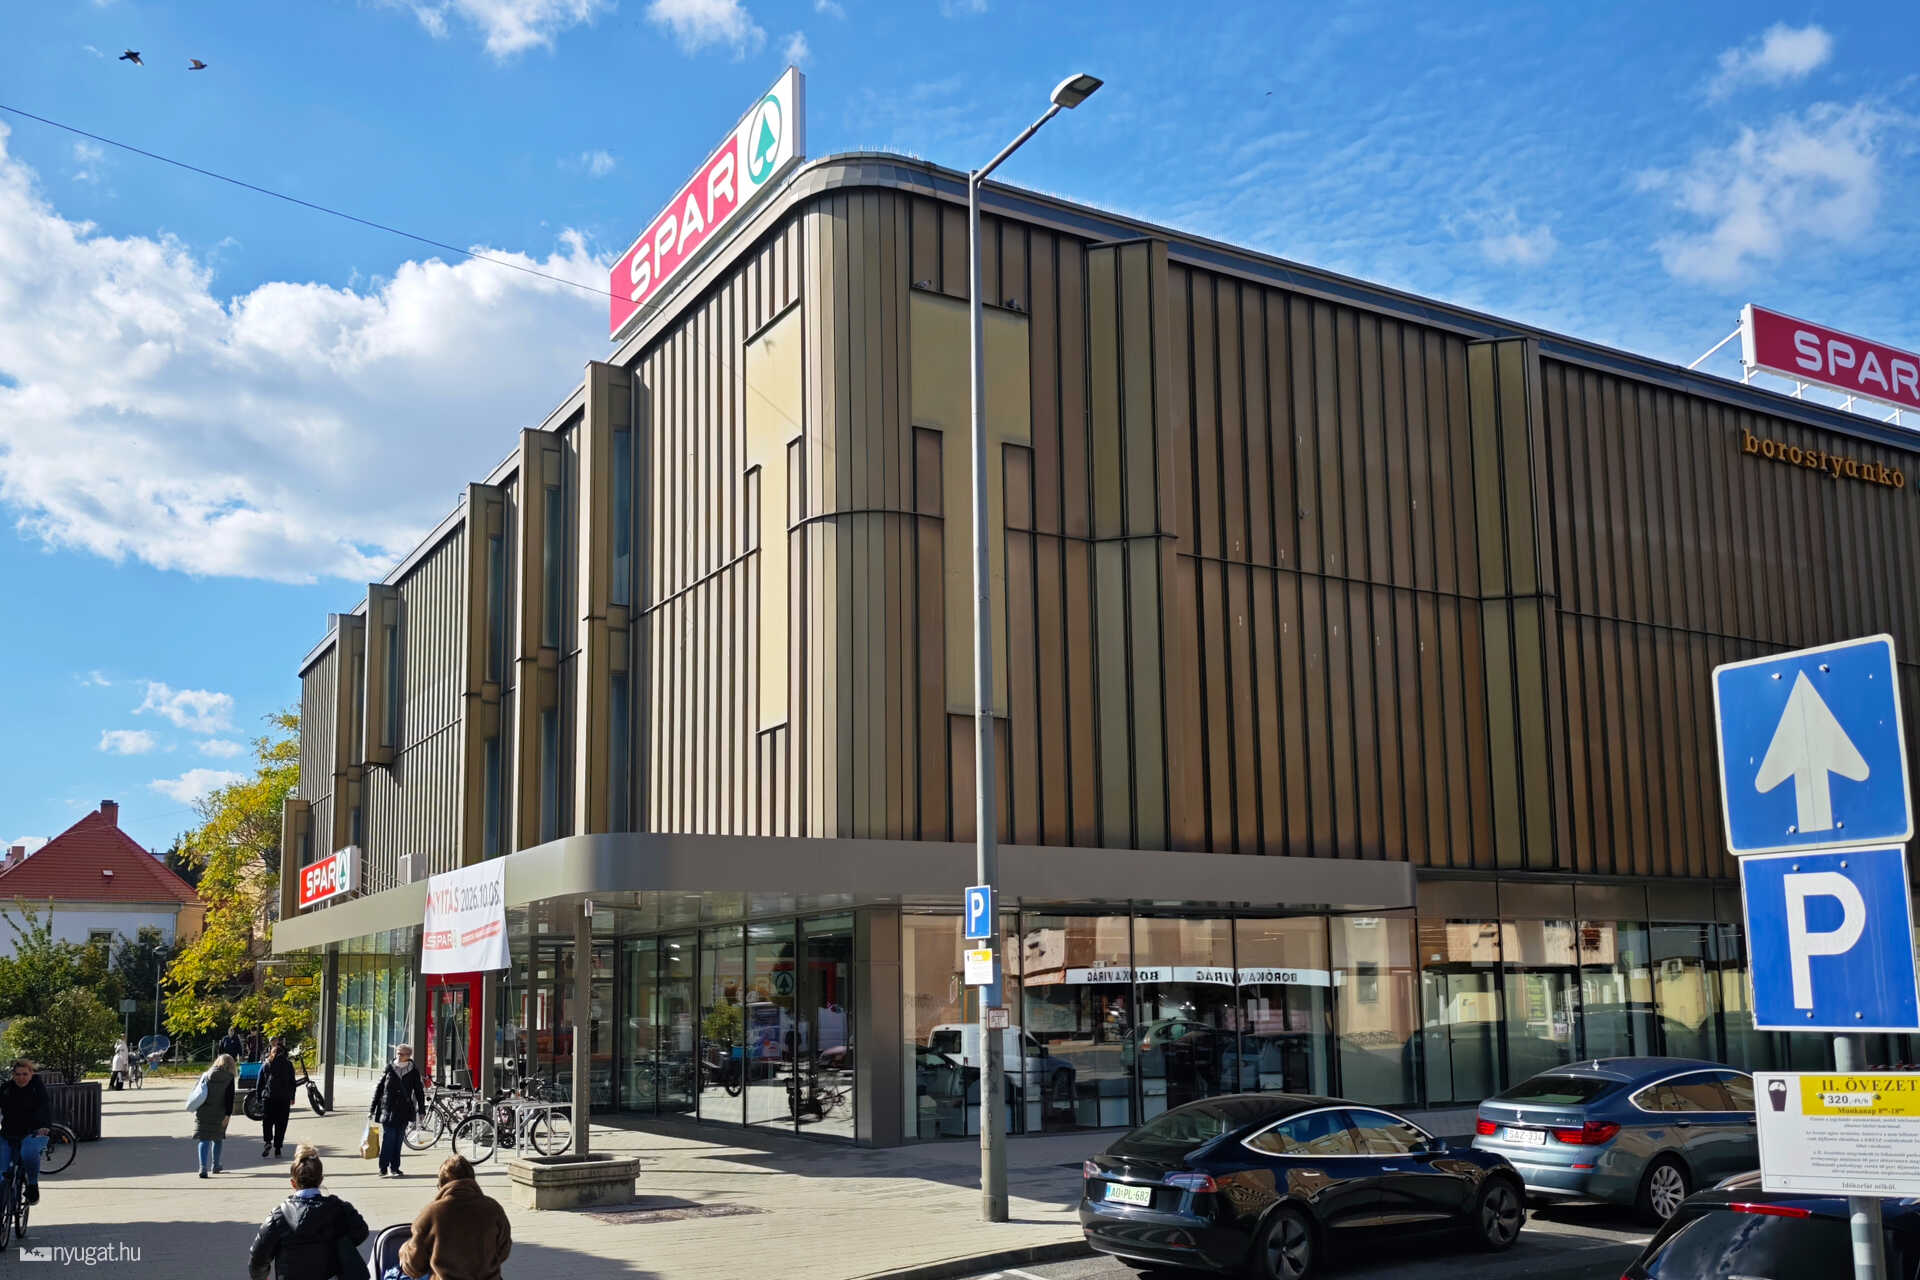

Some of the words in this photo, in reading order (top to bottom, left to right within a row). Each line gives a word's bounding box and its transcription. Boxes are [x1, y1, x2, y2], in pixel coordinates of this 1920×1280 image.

[631, 151, 735, 302] SPAR
[1793, 329, 1919, 400] SPAR
[306, 864, 336, 898] SPAR
[970, 892, 985, 933] P
[426, 934, 453, 947] SPAR
[1783, 871, 1866, 1010] P
[1821, 1079, 1840, 1092] II.
[1827, 1095, 1849, 1105] 320
